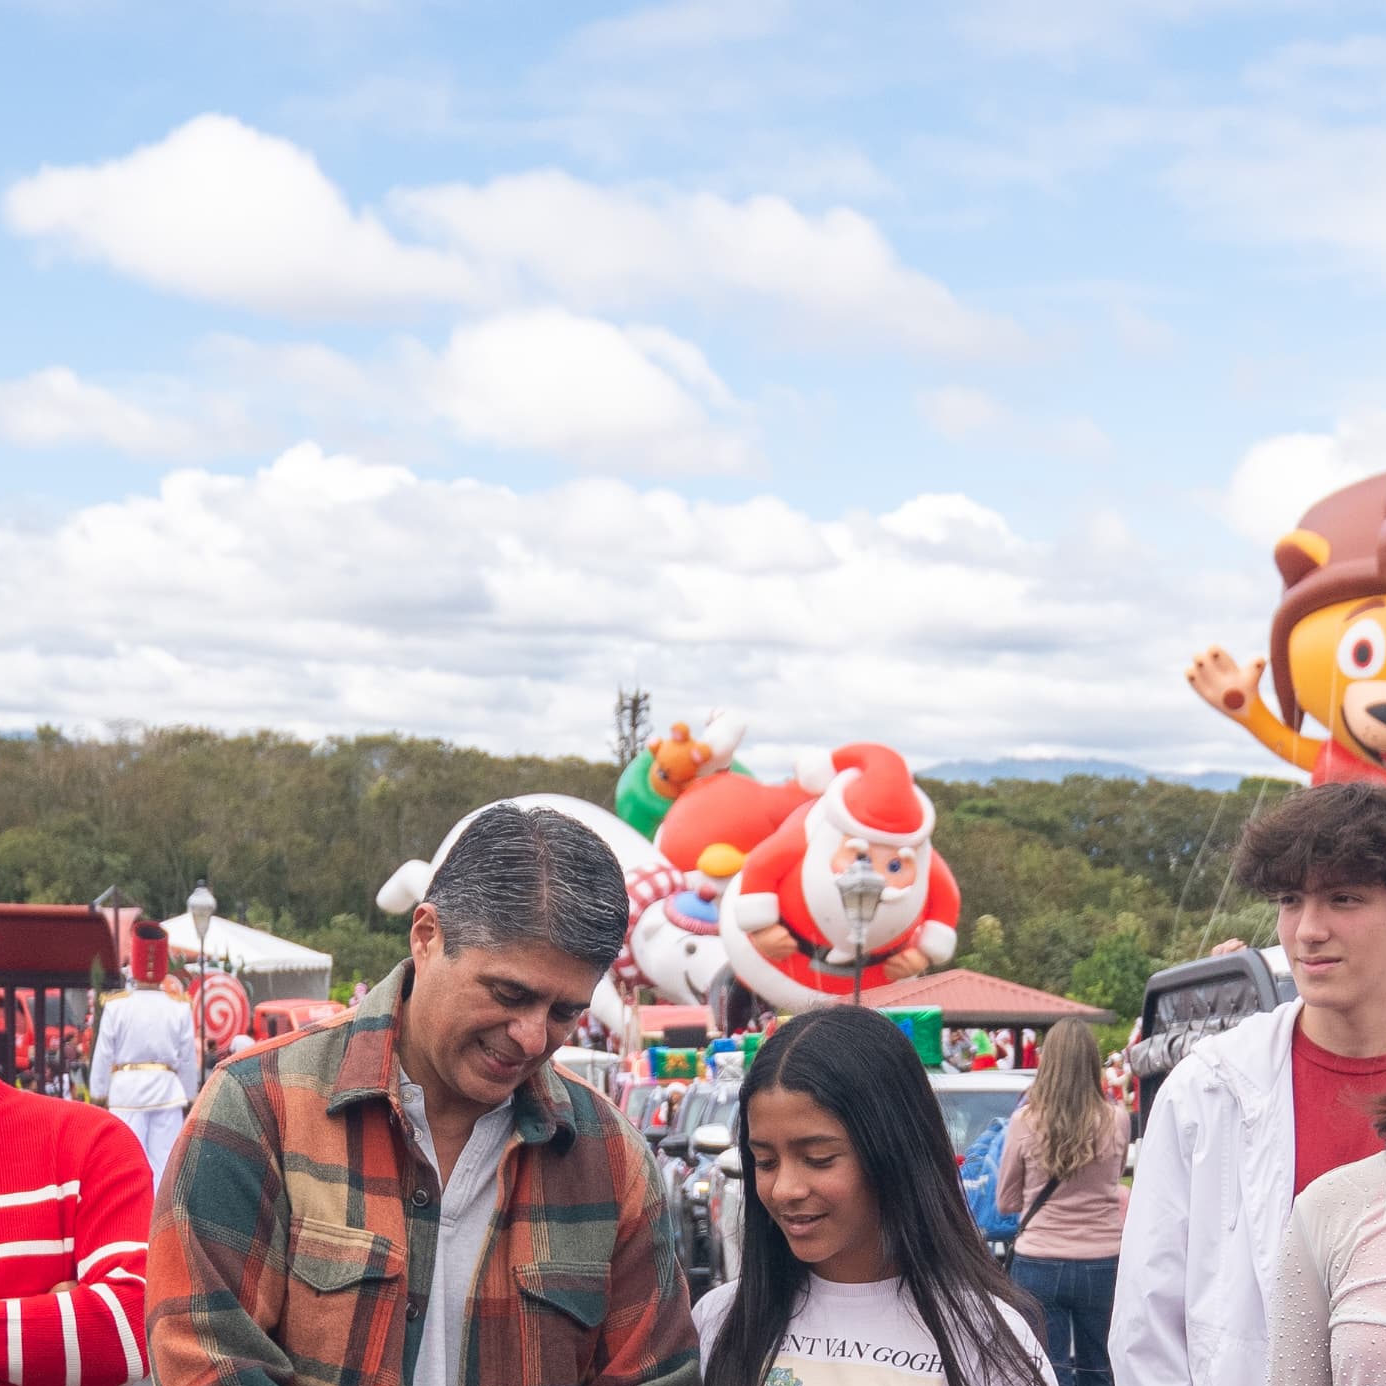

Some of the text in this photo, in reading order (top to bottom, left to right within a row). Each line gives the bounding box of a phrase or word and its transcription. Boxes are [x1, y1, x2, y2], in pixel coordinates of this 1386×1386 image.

[779, 1334, 943, 1374] ENT VAN GOGH
